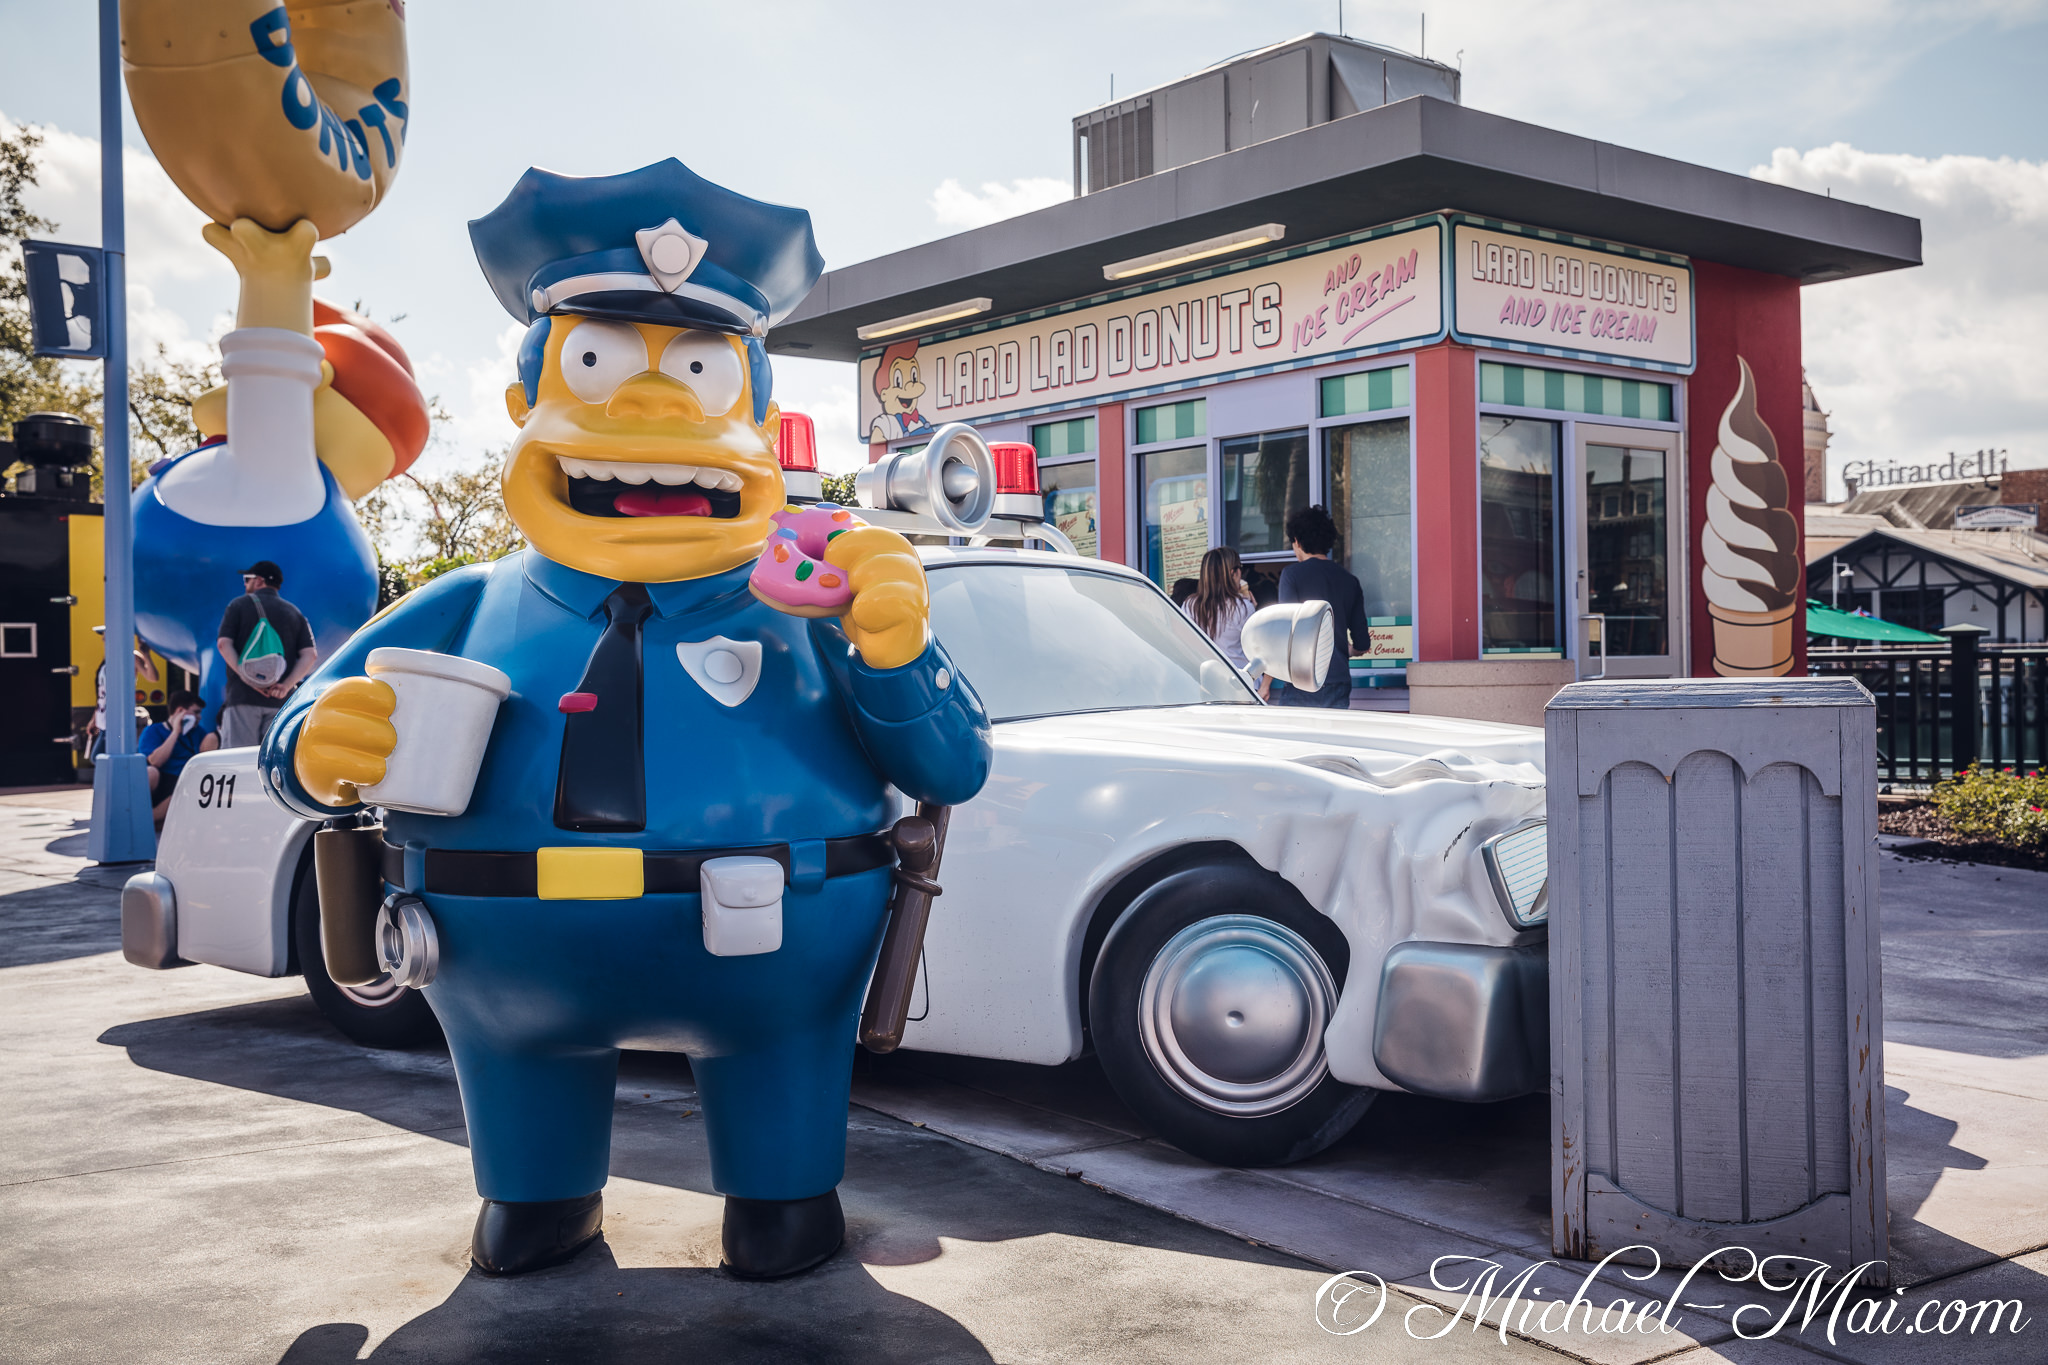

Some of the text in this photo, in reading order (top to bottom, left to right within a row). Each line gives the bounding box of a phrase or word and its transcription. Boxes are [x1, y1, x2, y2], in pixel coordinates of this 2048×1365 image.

[1323, 253, 1361, 297] AND
[1472, 240, 1677, 314] LARD LAD DONUTS
[1292, 248, 1418, 353] ICE CREAM
[1500, 295, 1658, 343] AND ICE CREAM
[936, 282, 1282, 410] LARD LAD DONUTS
[1842, 449, 2006, 487] Ghirardelli
[198, 774, 236, 808] 911
